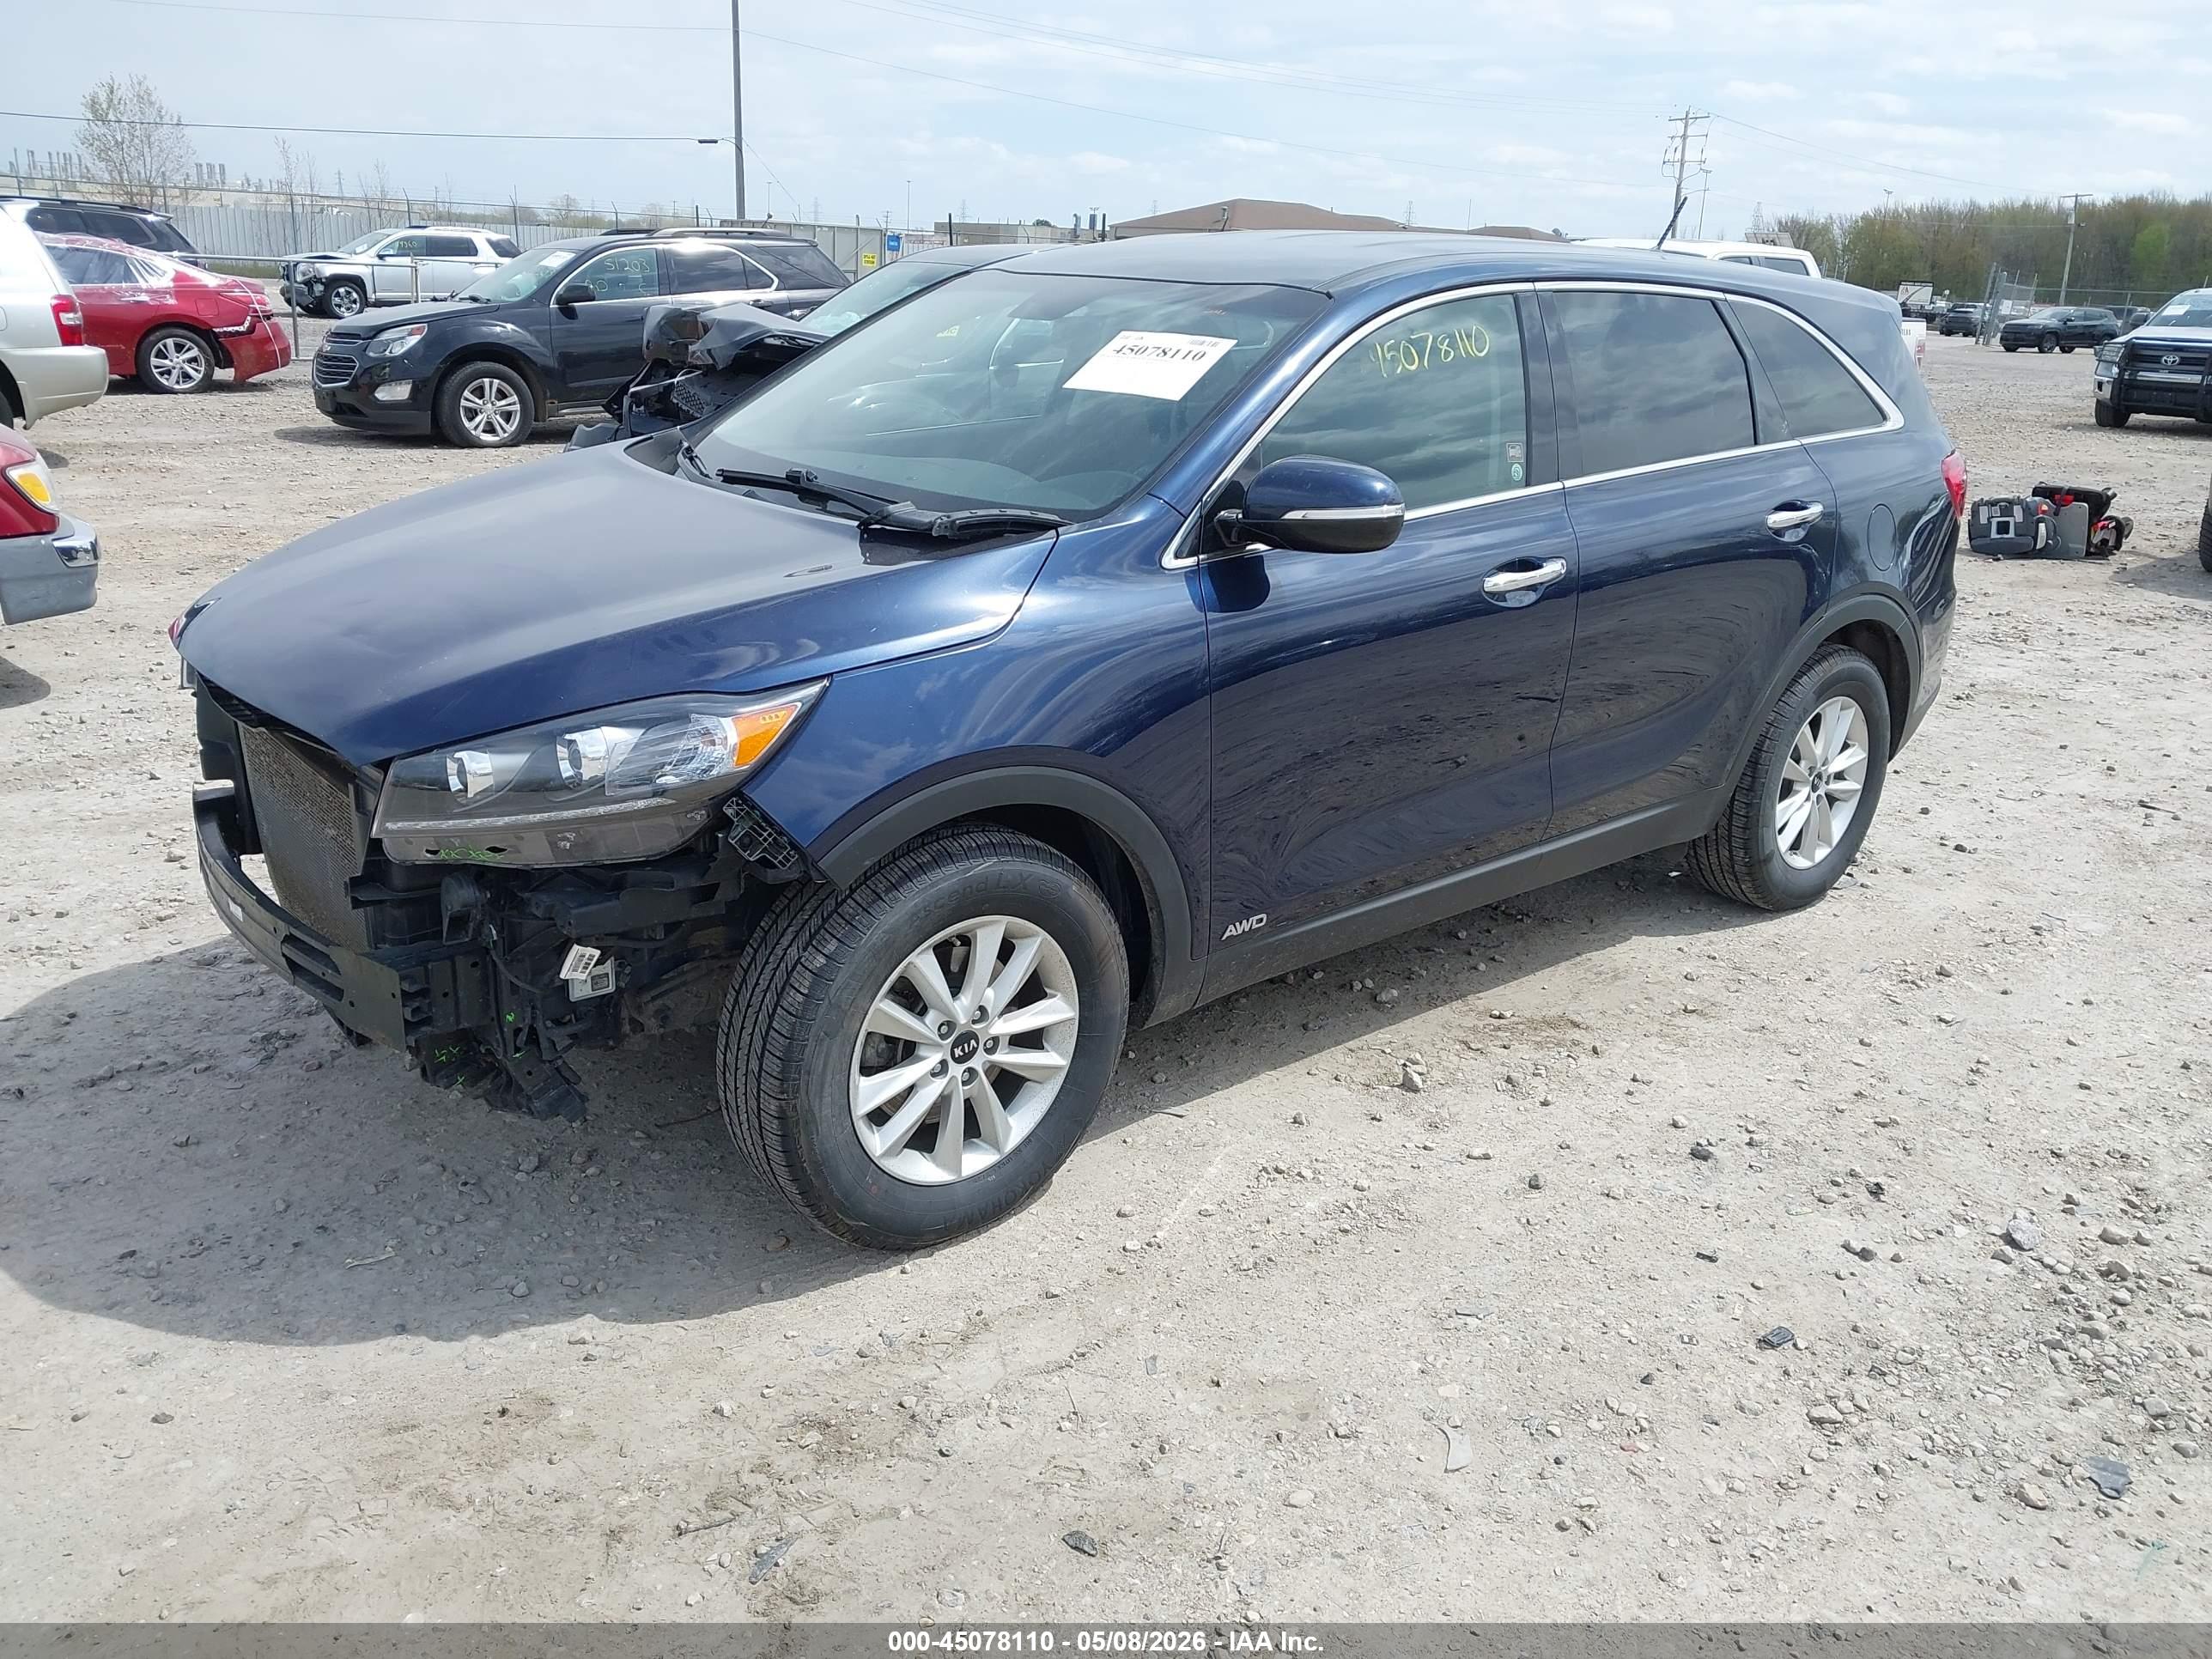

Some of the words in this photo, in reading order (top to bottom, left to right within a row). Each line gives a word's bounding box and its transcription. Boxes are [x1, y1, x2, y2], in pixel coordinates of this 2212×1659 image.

[1112, 343, 1206, 362] 45078110
[1220, 913, 1267, 941] AWD
[953, 1038, 978, 1059] KIA
